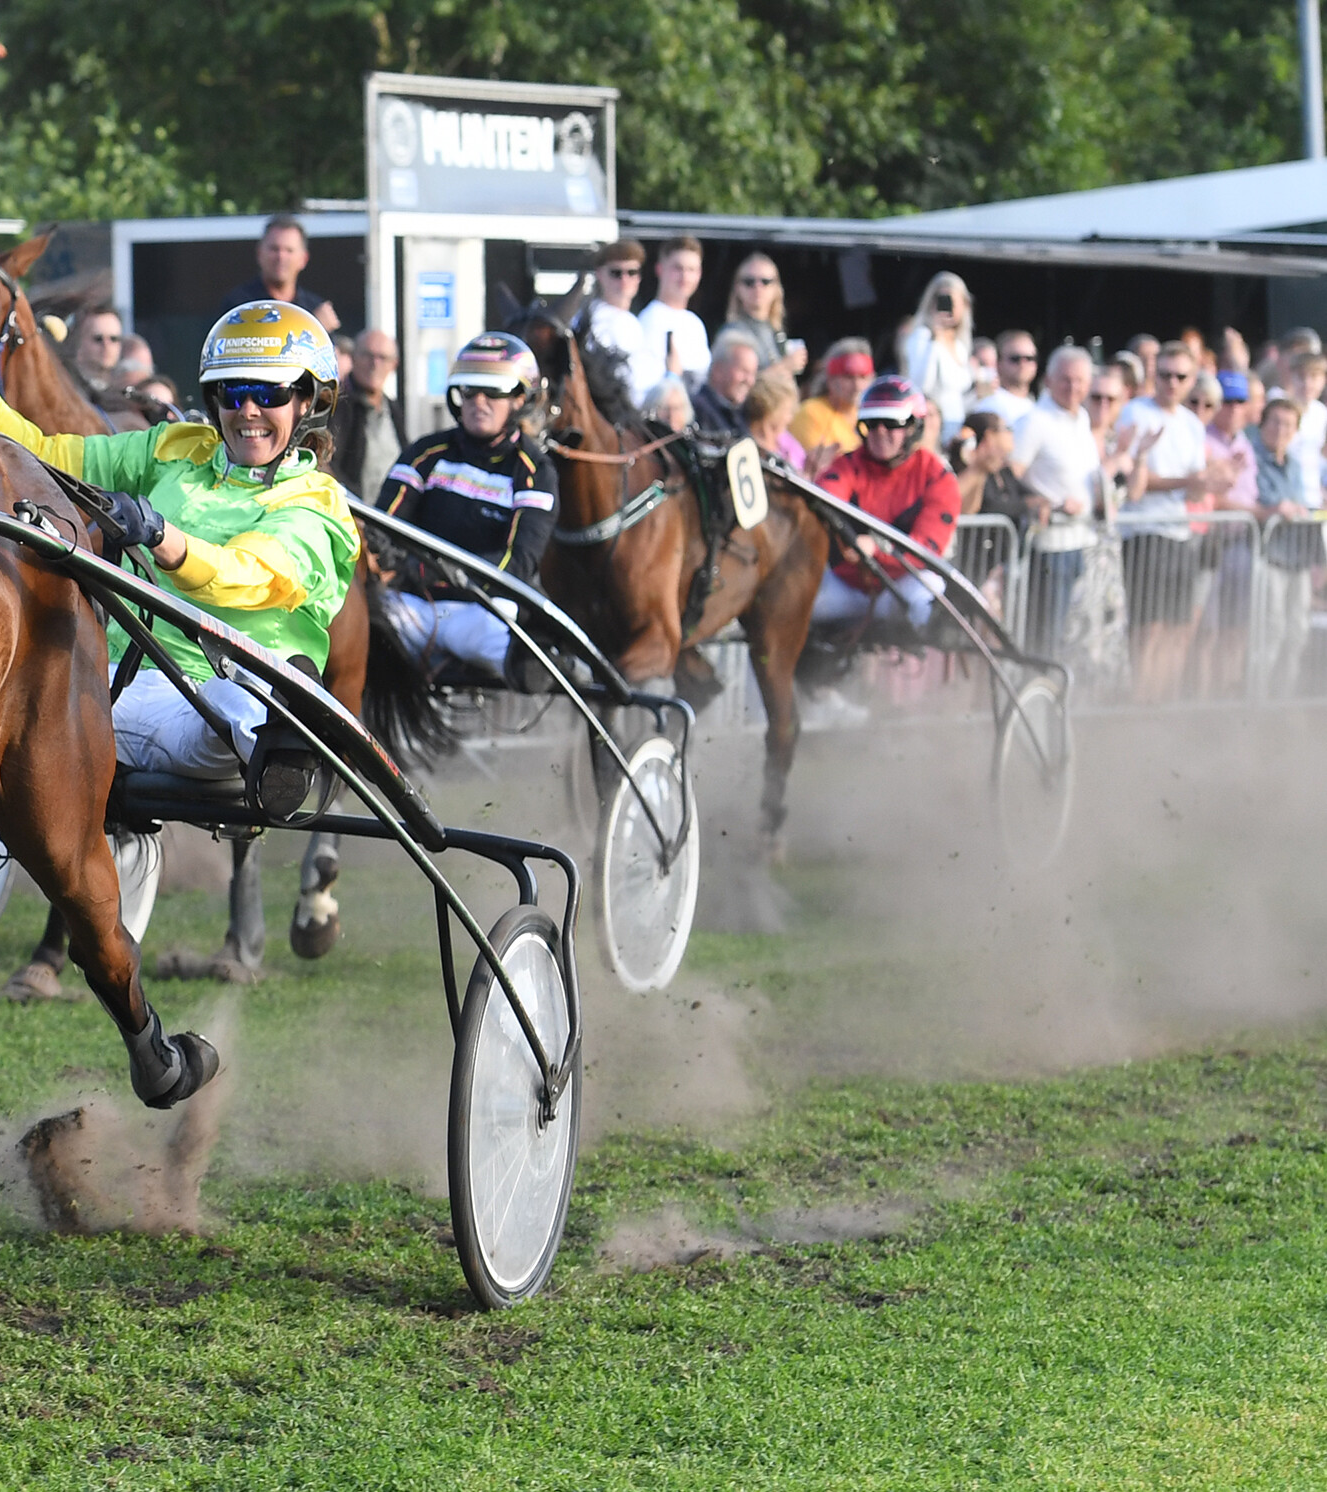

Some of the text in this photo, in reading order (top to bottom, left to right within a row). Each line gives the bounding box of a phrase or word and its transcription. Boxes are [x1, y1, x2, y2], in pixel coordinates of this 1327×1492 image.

[420, 108, 555, 172] MUNTEN
[227, 337, 281, 347] KNIPSCHEER
[737, 456, 755, 510] 6
